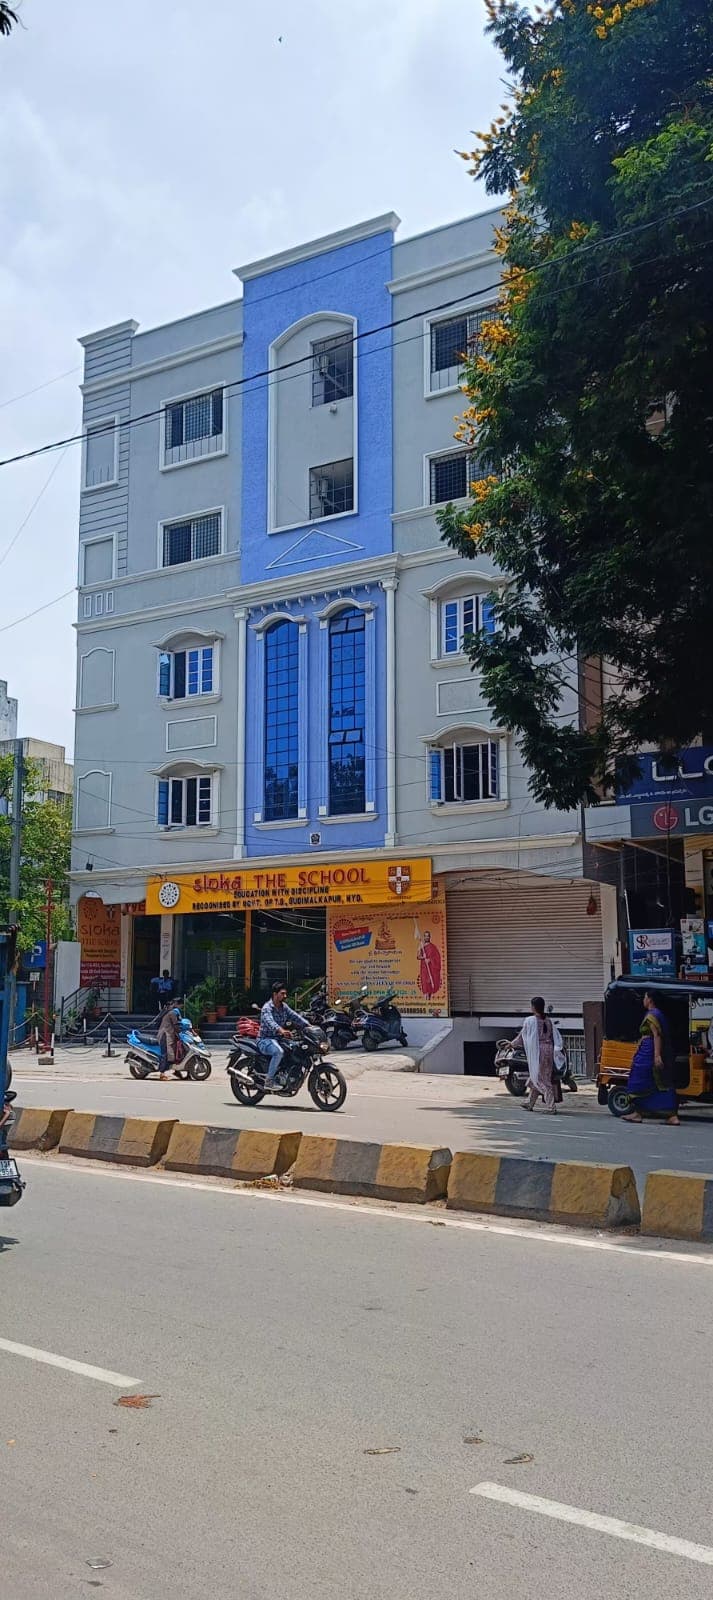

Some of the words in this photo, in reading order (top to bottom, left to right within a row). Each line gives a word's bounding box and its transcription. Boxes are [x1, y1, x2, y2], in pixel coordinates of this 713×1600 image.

[193, 873, 242, 893] sloka
[253, 873, 287, 889] THE
[298, 867, 371, 886] SCHOOL
[234, 888, 270, 899] EDUCATION
[272, 887, 289, 897] WITH
[291, 885, 329, 895] DISCIPLINE
[192, 901, 231, 911] RECOGNISED
[232, 901, 241, 909] BY
[81, 923, 120, 937] sloka
